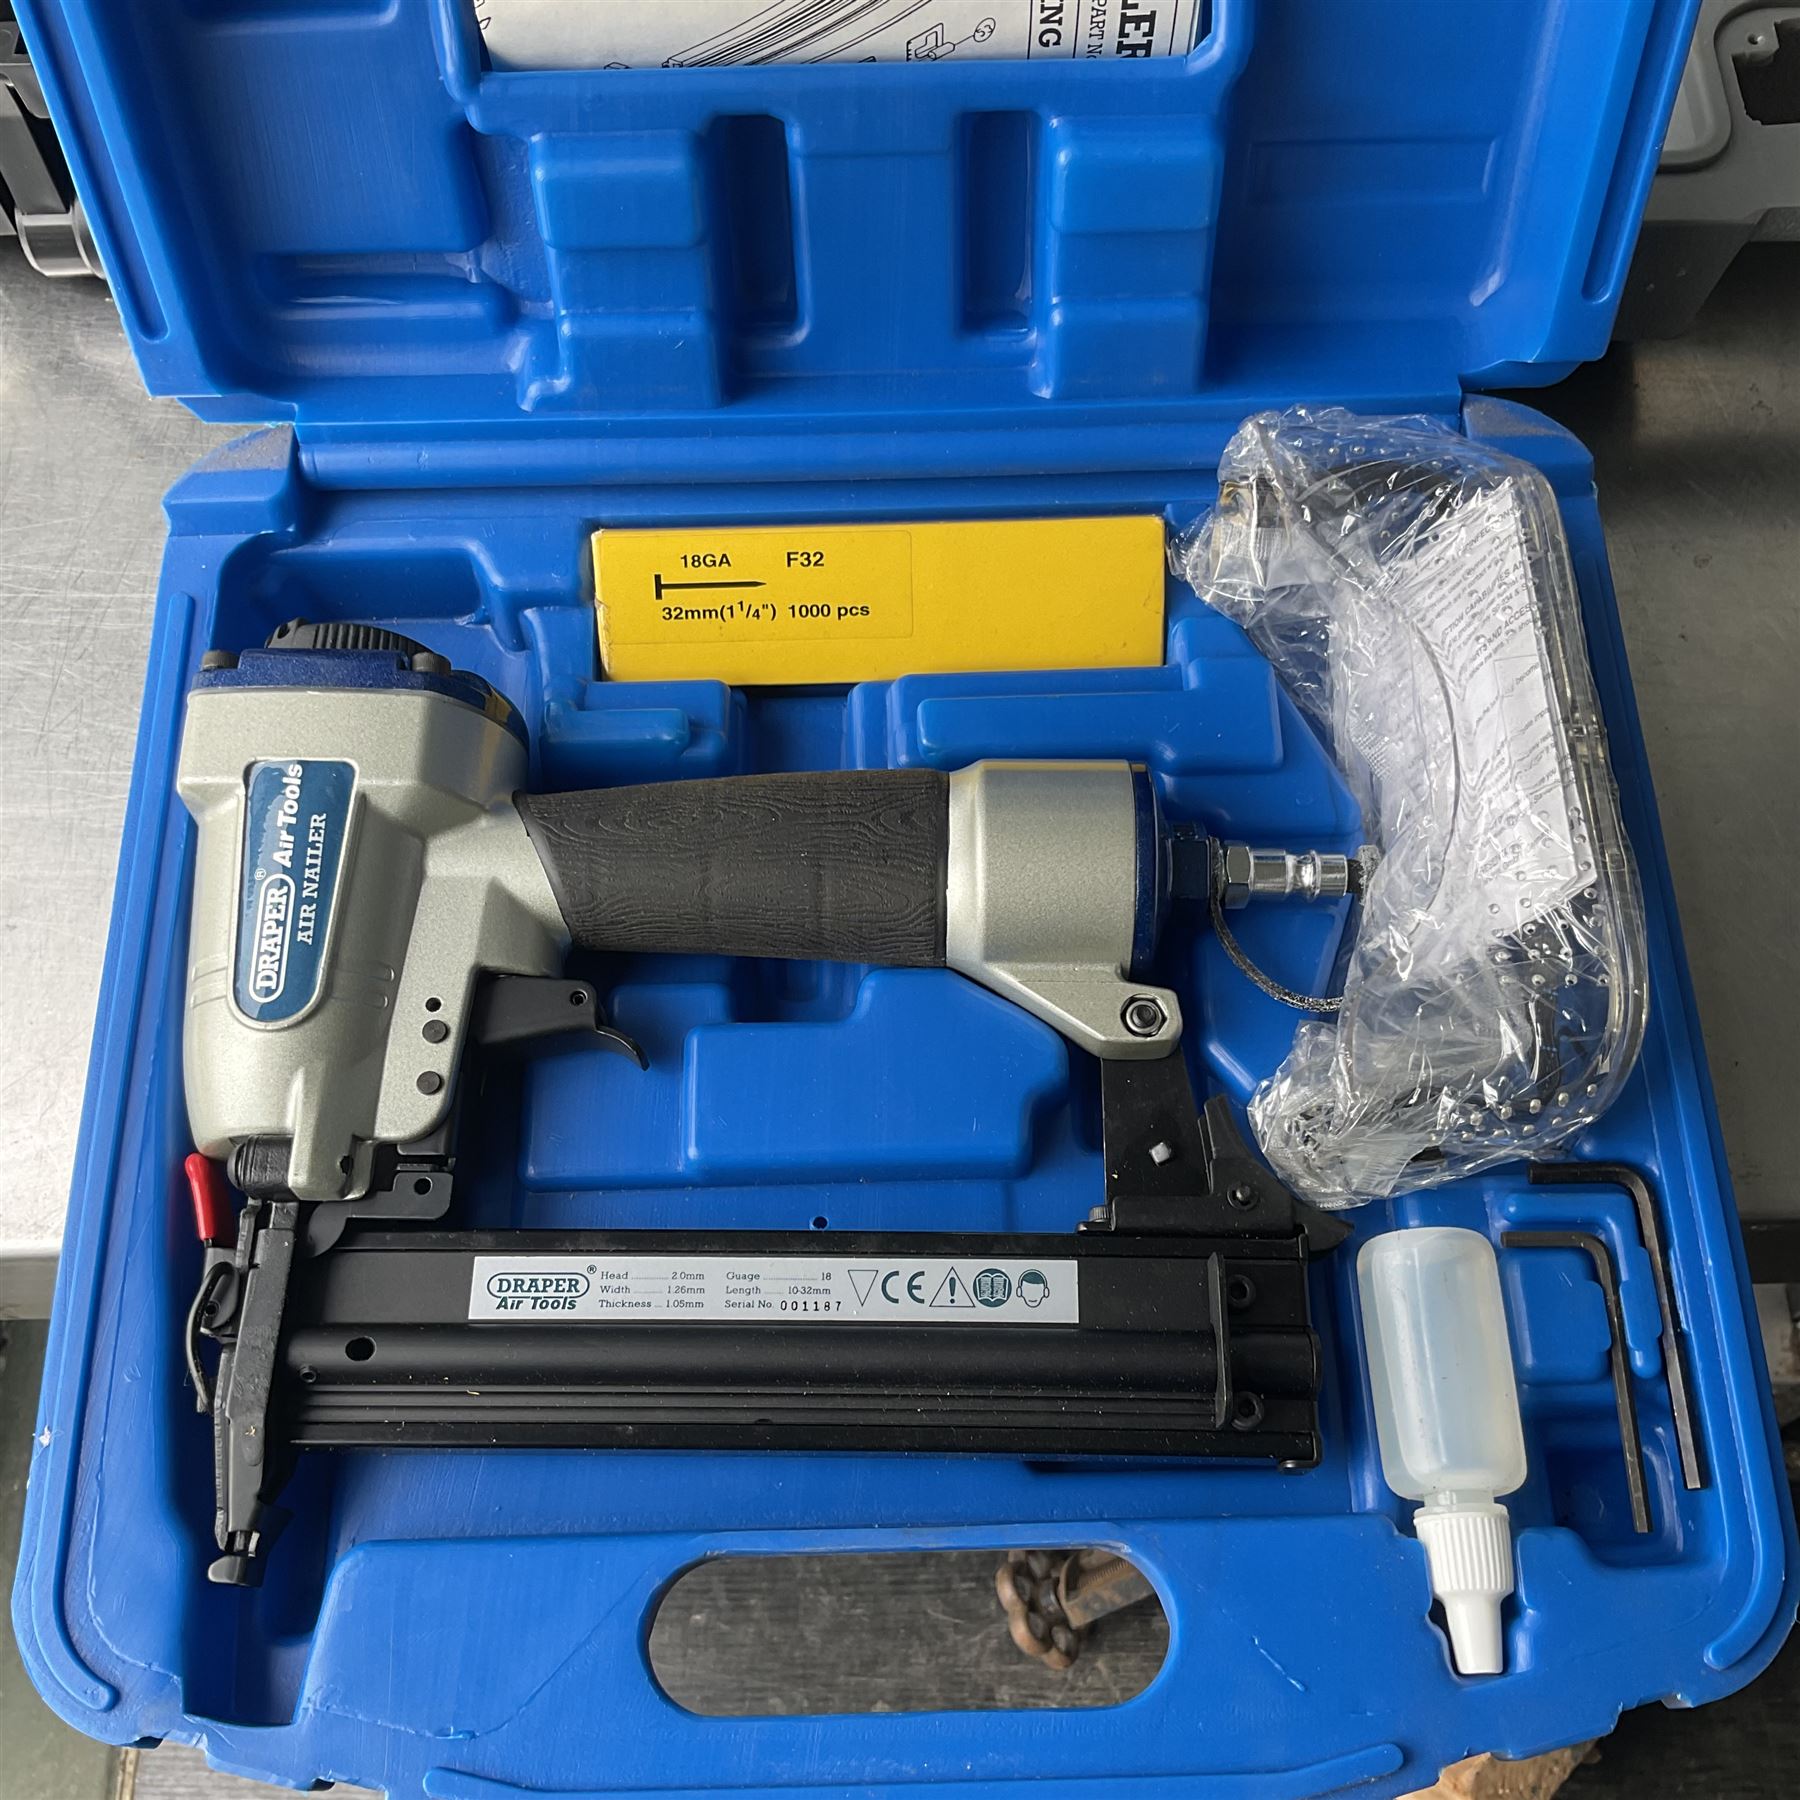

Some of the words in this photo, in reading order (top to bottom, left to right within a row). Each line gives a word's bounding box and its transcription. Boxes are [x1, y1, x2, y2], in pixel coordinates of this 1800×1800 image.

[680, 553, 732, 569] 18GA
[786, 551, 825, 567] F32
[787, 604, 831, 619] 1000
[837, 603, 870, 620] pcs
[276, 763, 304, 827] Tools
[272, 830, 295, 869] Air
[302, 812, 327, 898] NAILER
[297, 903, 317, 945] AIR
[256, 885, 289, 990] DRAPER
[600, 1271, 629, 1281] Head
[726, 1271, 761, 1282] Guage
[820, 1271, 832, 1281] 18
[496, 1278, 580, 1293] DRAPER
[600, 1285, 631, 1294] Width
[725, 1285, 762, 1296] Length
[496, 1297, 524, 1310] Air
[530, 1296, 577, 1310] Tools
[599, 1299, 652, 1309] Thickness
[665, 1300, 704, 1309] 1.05mm
[724, 1300, 756, 1310] Serial
[780, 1301, 842, 1312] 001187
